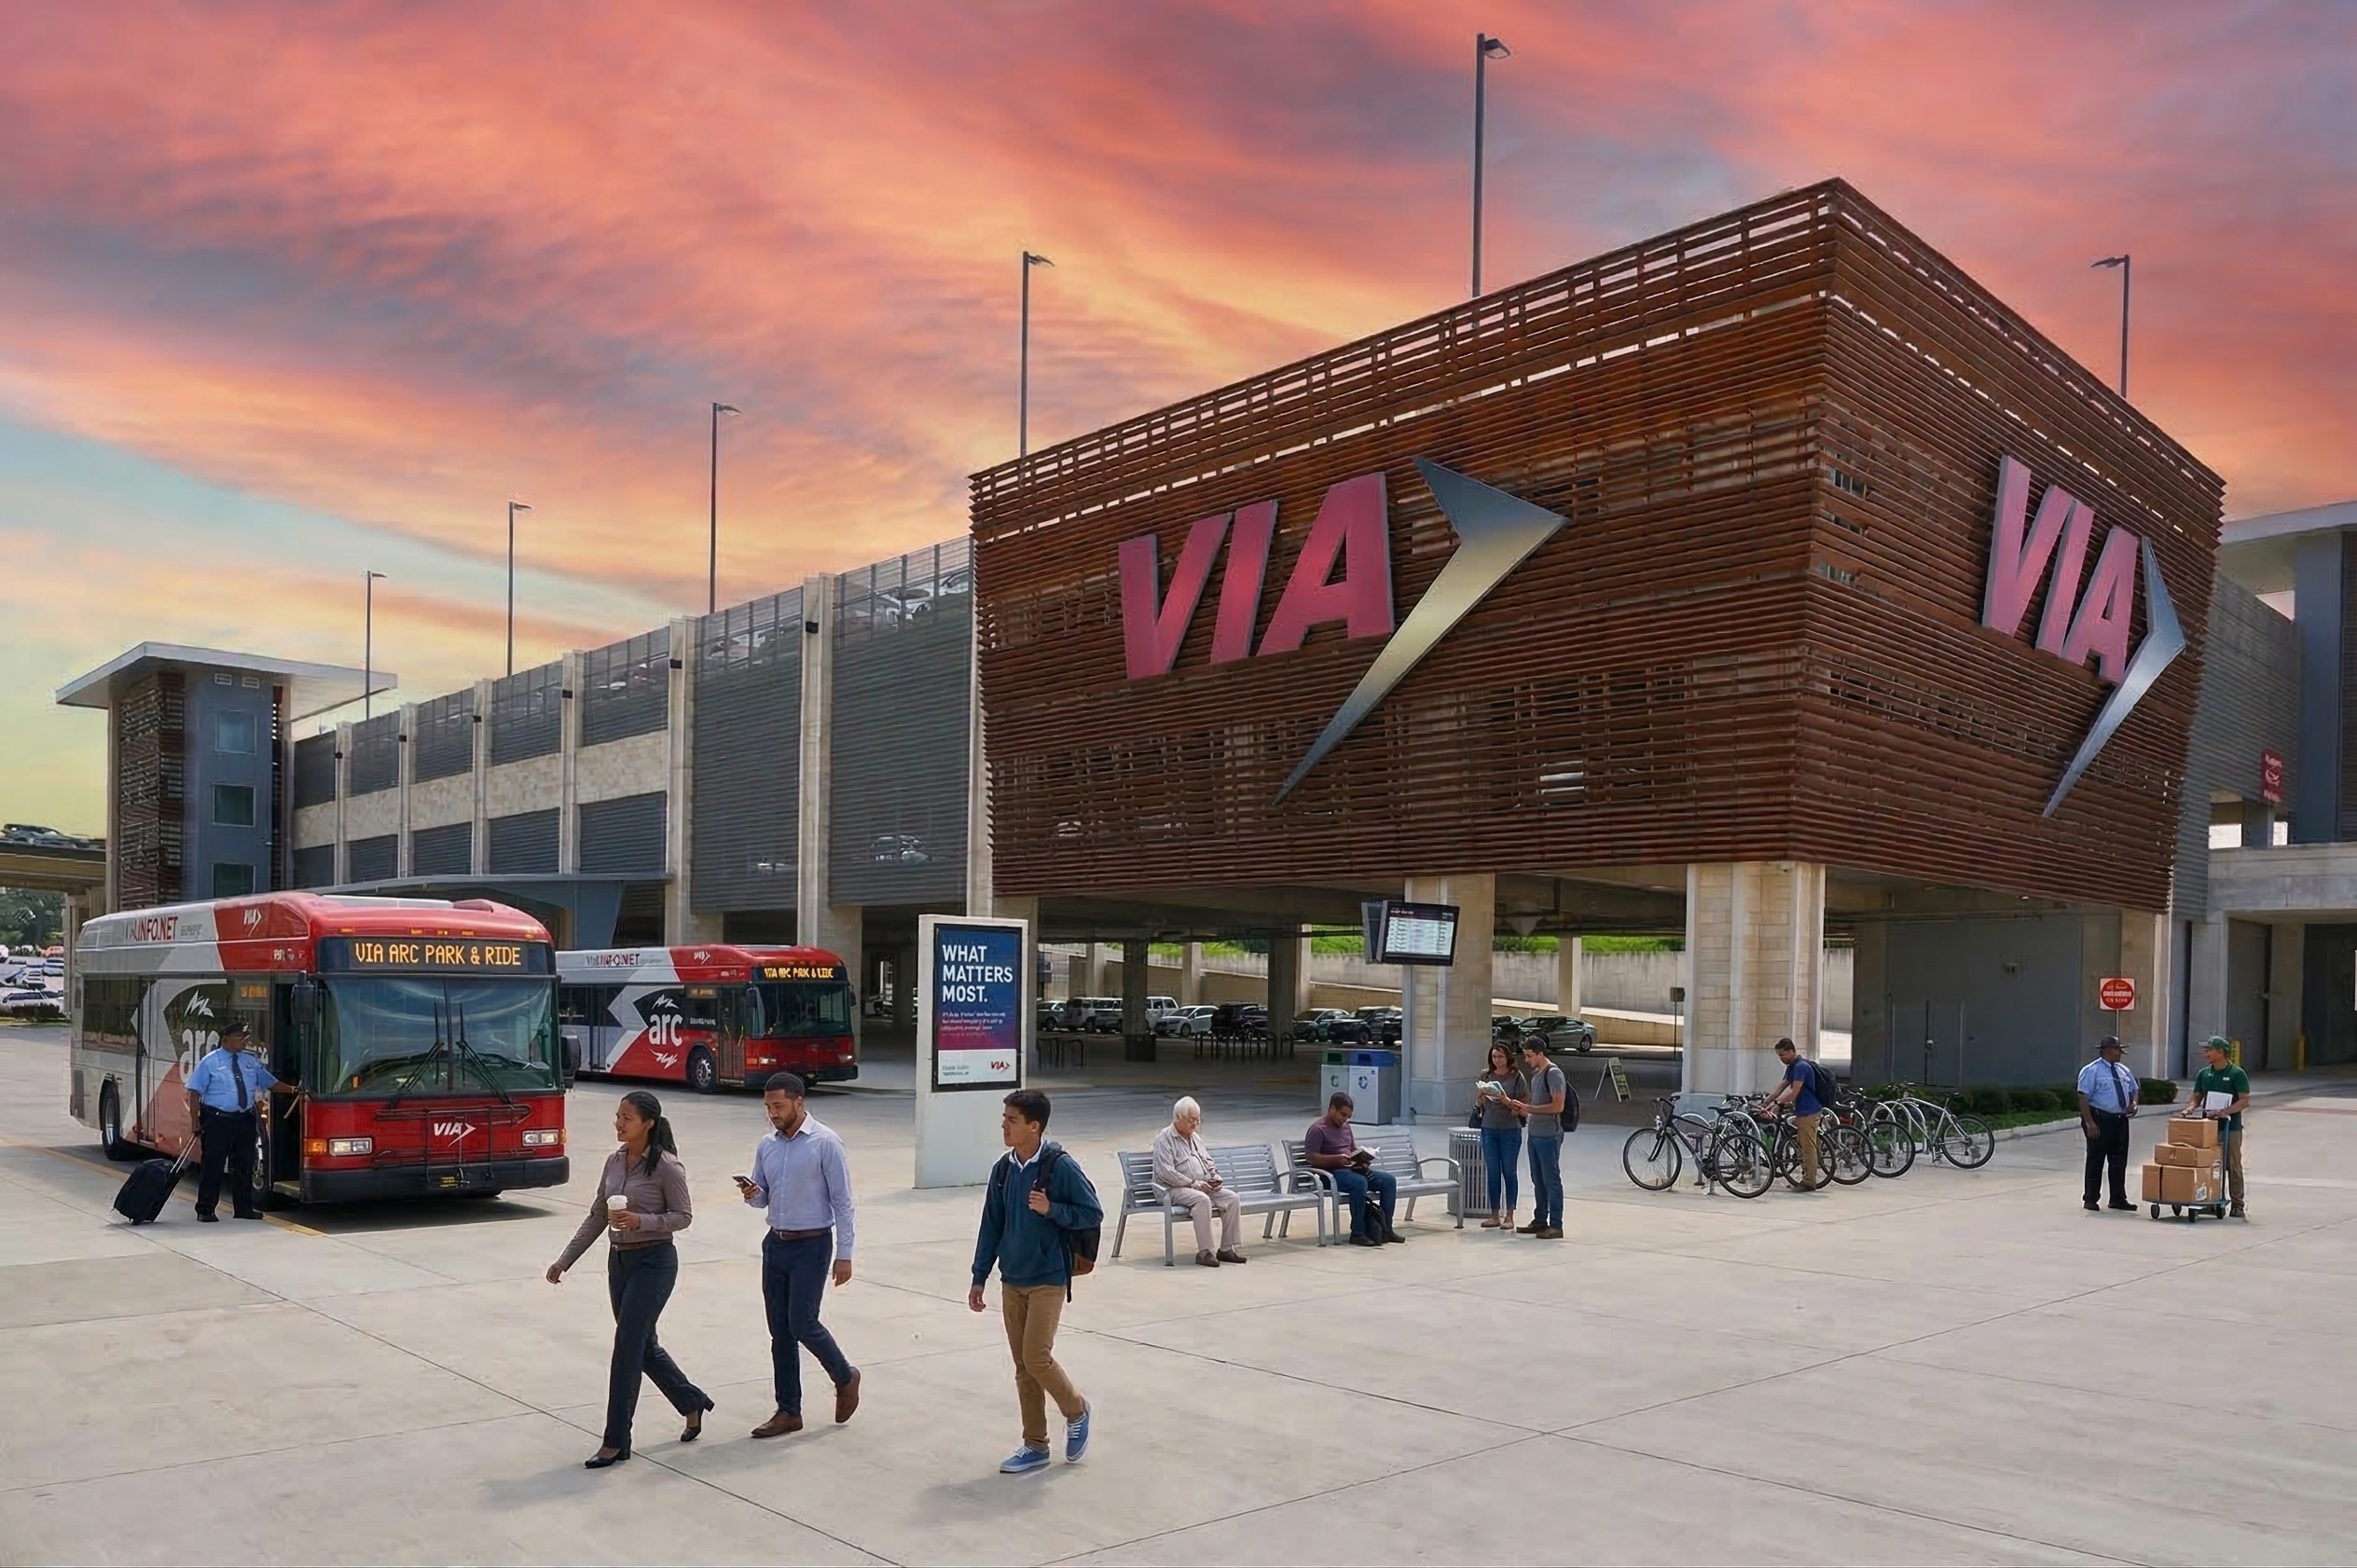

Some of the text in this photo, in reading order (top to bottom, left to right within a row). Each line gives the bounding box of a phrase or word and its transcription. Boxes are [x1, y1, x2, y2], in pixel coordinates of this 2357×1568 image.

[1119, 472, 1394, 680] VIA
[1982, 454, 2139, 685] VIA
[355, 942, 521, 966] VIA ARC PARK & RIDE
[942, 944, 987, 963] WHAT
[943, 964, 1013, 983] MATTERS
[943, 984, 988, 1003] MOST.
[648, 1013, 683, 1047] arc
[991, 1061, 1005, 1070] VIA
[434, 1122, 463, 1136] VIA
